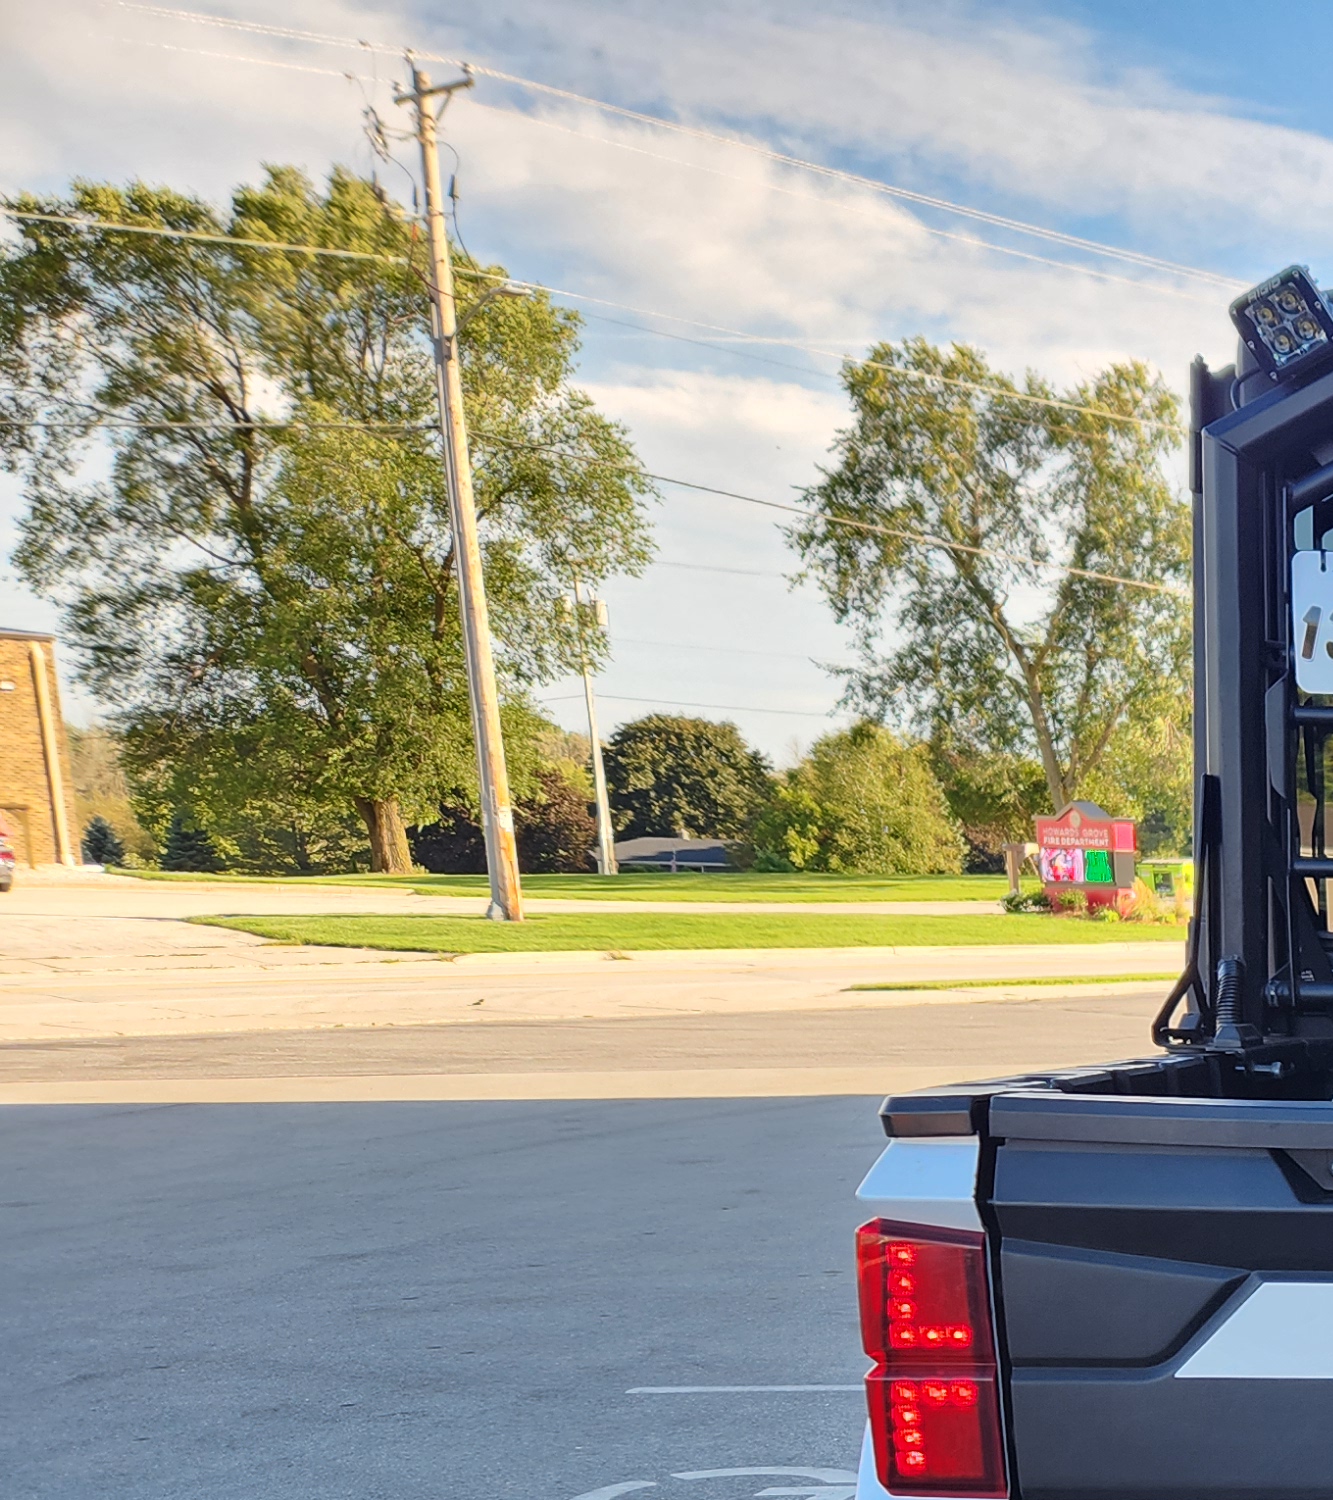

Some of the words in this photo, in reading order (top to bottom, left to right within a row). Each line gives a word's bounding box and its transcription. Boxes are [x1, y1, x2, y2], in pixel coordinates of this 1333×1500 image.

[1043, 827, 1079, 838] HOWARDS
[1082, 828, 1108, 838] GROVE
[1043, 836, 1060, 845] FIRE
[1061, 837, 1109, 847] DEPARTMENT
